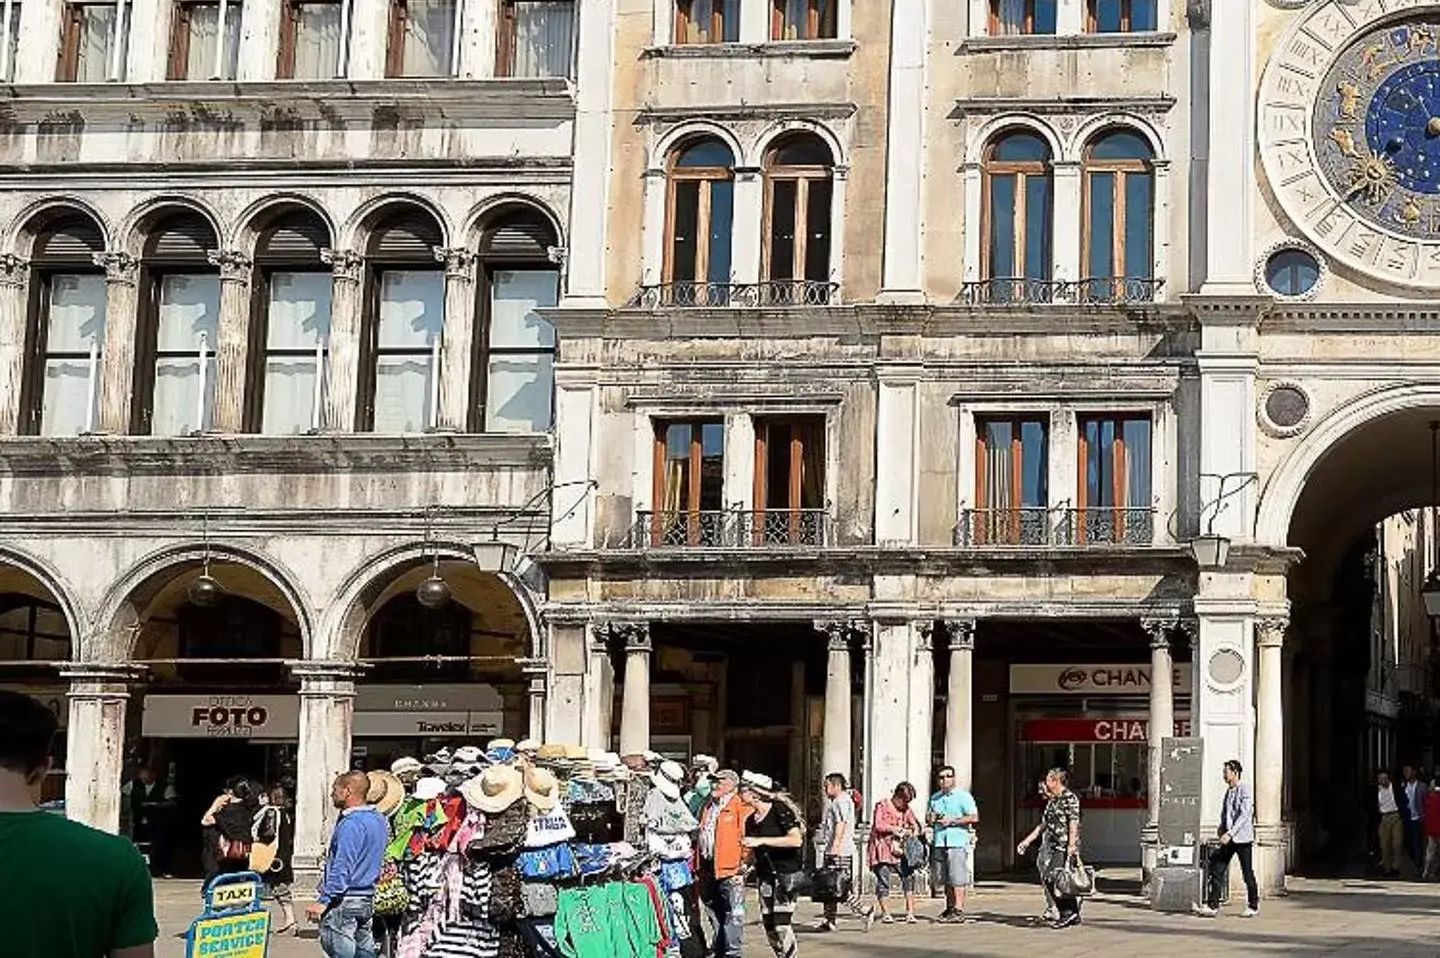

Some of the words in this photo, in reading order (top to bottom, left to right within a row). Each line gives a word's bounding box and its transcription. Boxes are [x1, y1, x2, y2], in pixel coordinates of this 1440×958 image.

[1092, 670, 1181, 686] CHANE
[192, 707, 267, 726] FOTO
[416, 721, 466, 733] Travelex
[216, 888, 253, 902] TAXI
[201, 918, 265, 939] PORTER
[199, 933, 264, 955] SERVICE
